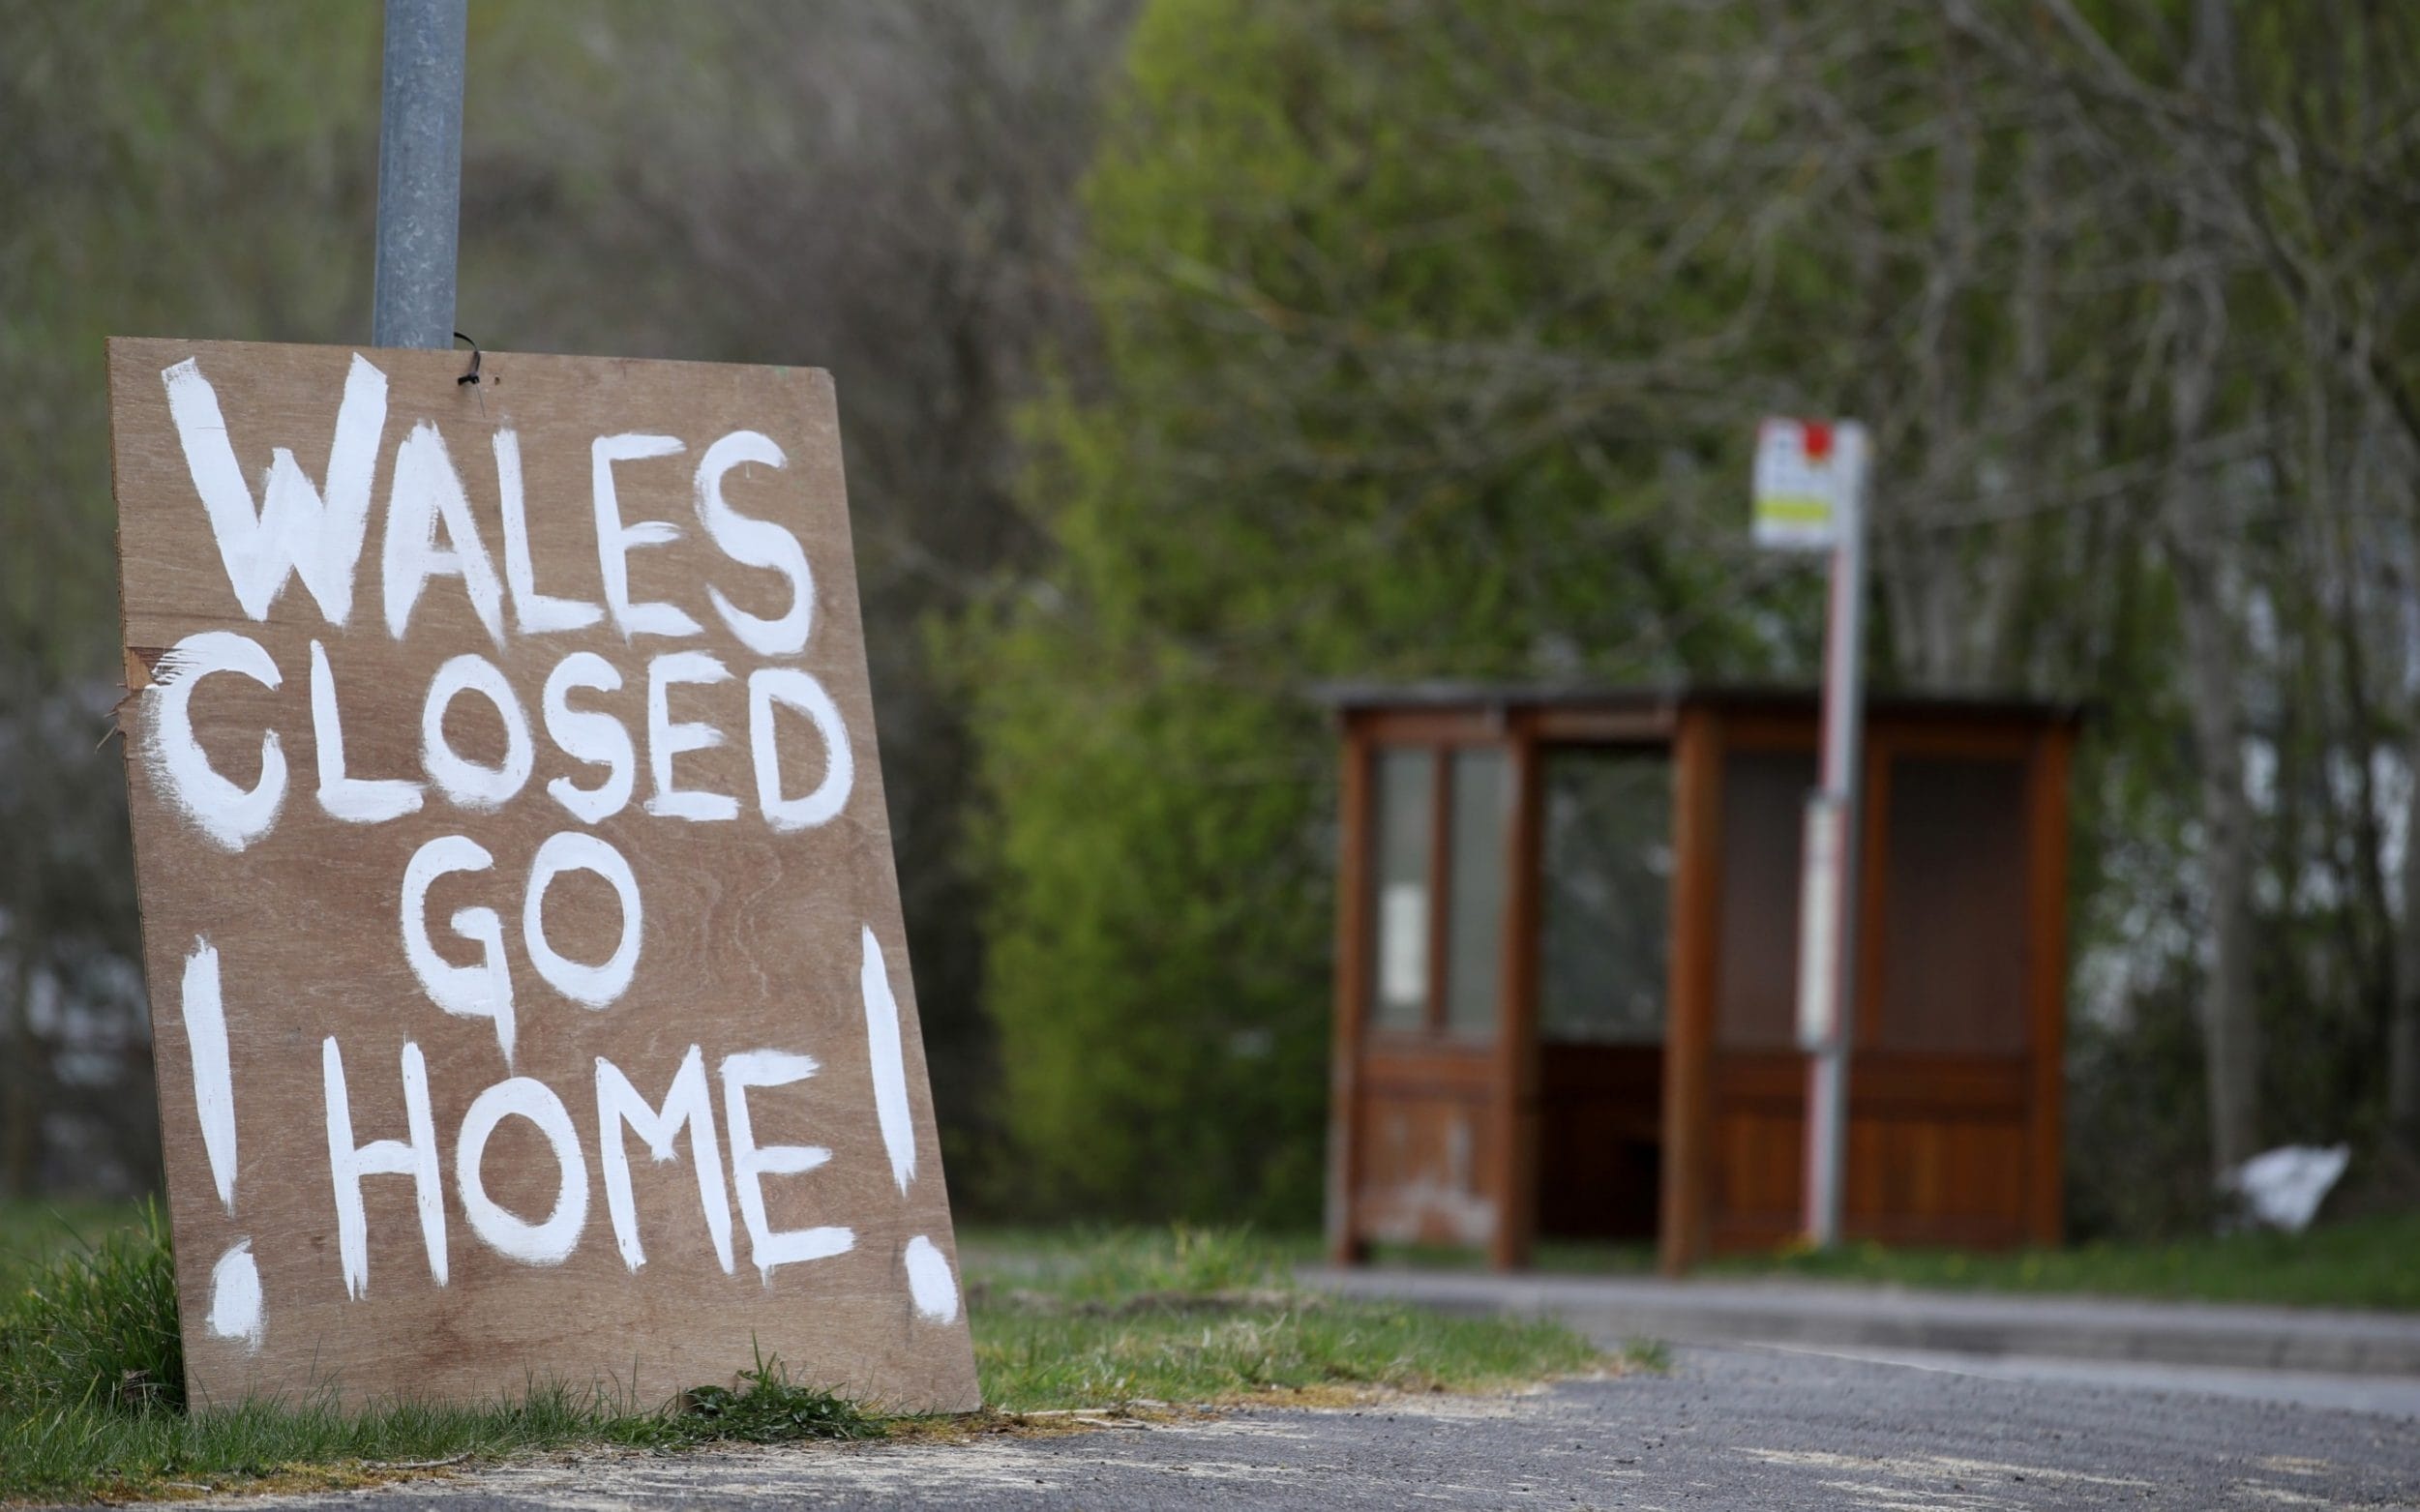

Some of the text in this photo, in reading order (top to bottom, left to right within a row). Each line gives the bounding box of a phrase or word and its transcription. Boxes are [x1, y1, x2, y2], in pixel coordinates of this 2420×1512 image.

[161, 352, 816, 658] WALES
[142, 630, 853, 852] CLOSED
[400, 830, 642, 1070] GO
[181, 926, 959, 1351] ! HOME !
